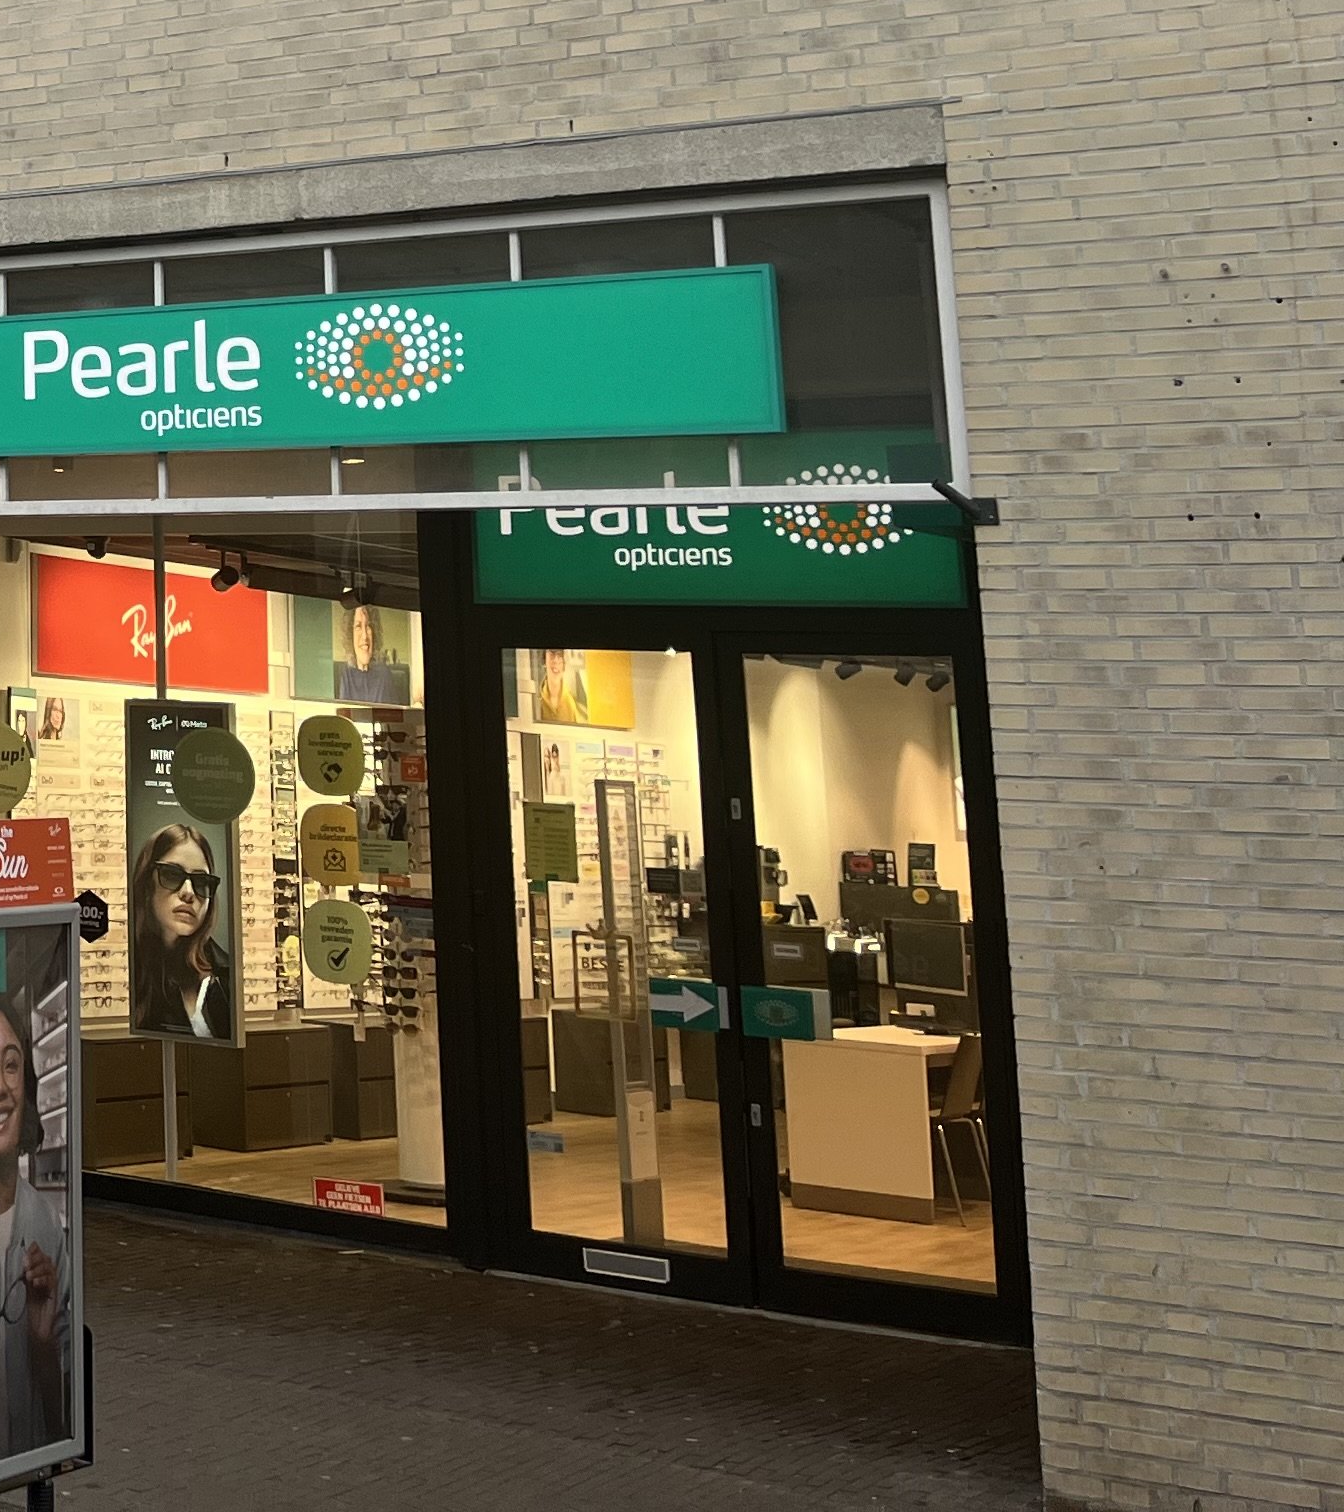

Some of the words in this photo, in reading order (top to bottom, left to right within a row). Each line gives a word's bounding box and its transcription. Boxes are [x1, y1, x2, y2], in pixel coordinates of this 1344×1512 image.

[23, 319, 261, 400] Pearle
[141, 404, 262, 436] opticiens
[614, 544, 732, 571] opticiens
[1, 747, 25, 766] up!
